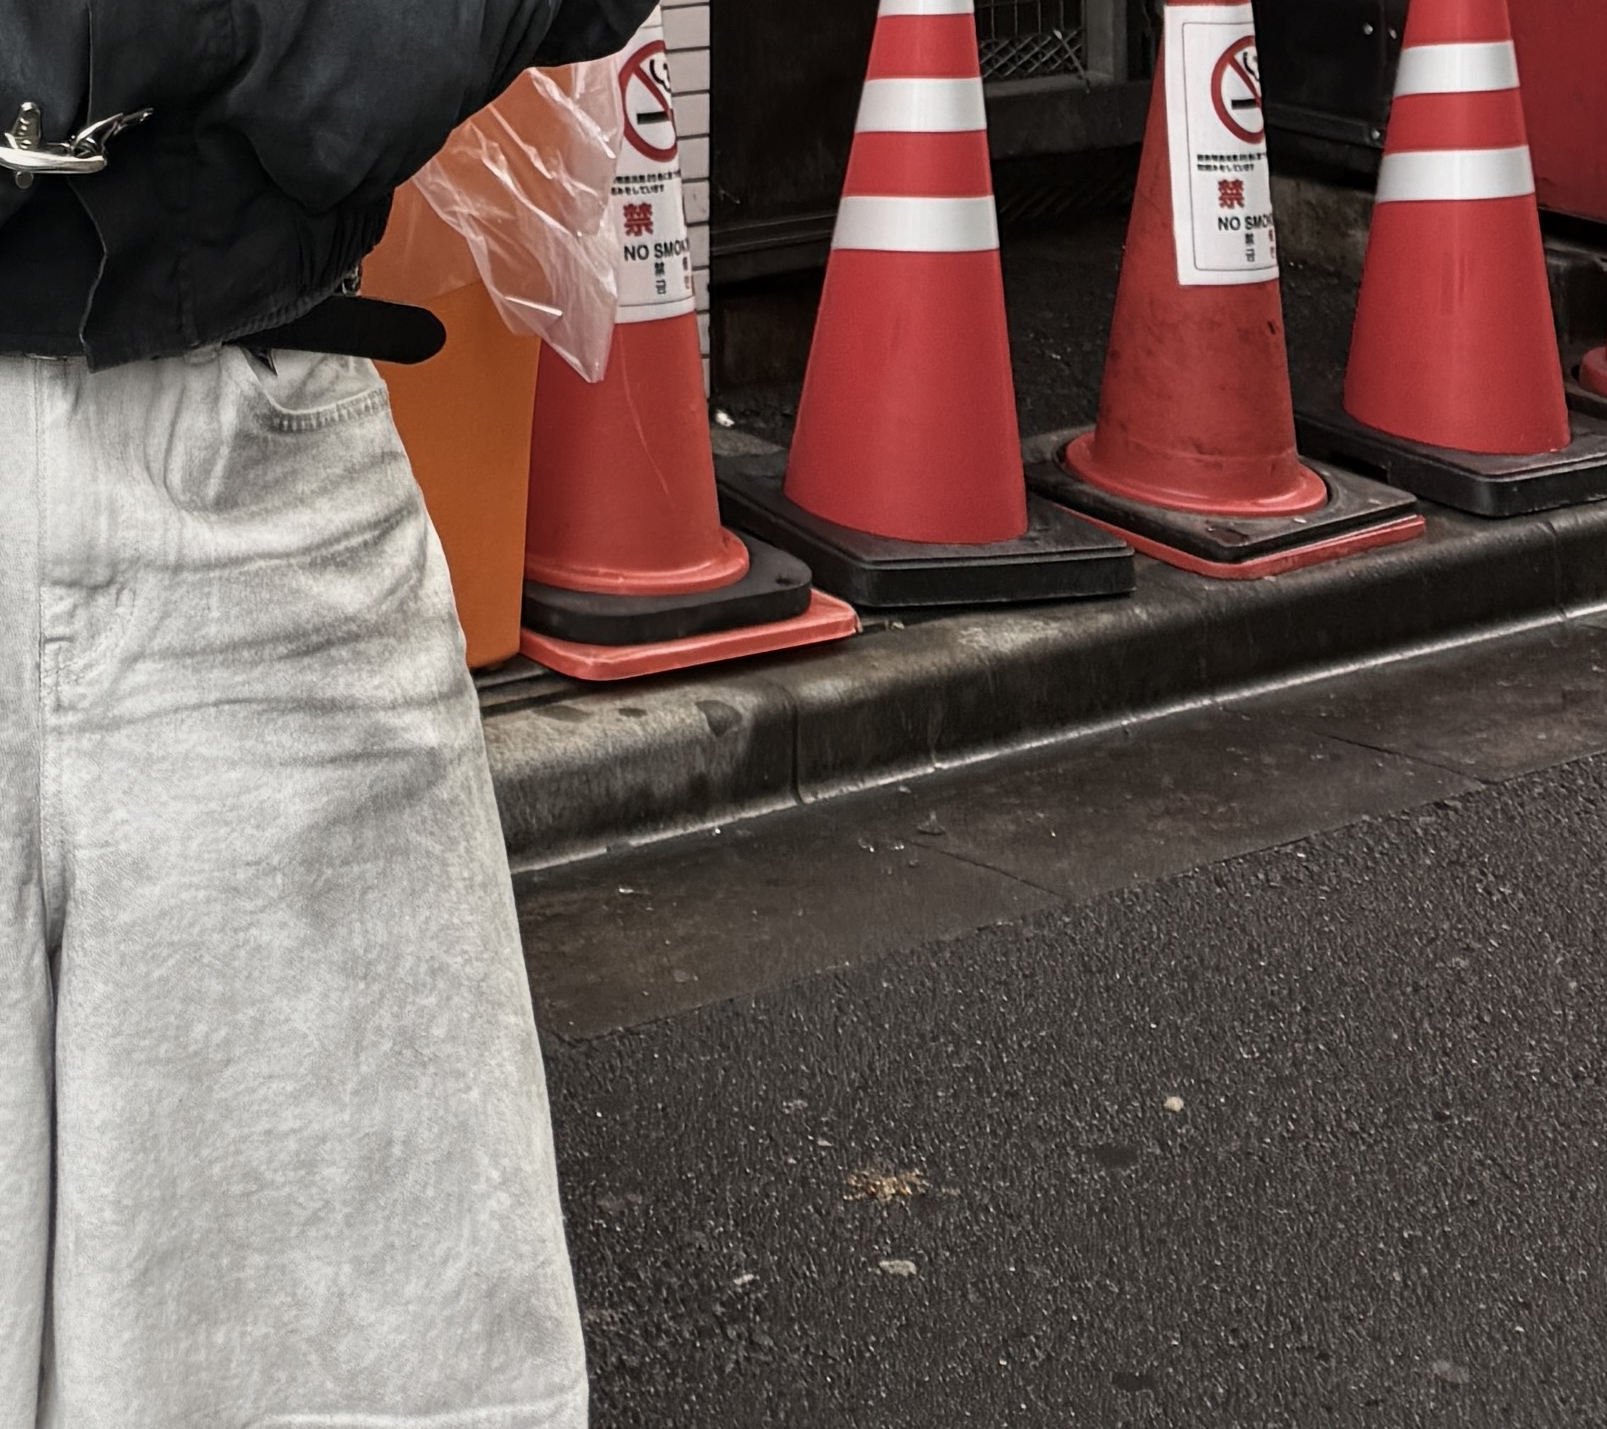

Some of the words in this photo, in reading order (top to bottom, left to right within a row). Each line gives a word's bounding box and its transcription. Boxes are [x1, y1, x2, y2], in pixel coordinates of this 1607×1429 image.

[1217, 178, 1245, 210] 禁
[622, 202, 654, 237] 禁
[1217, 216, 1241, 232] NO
[623, 243, 650, 262] NO
